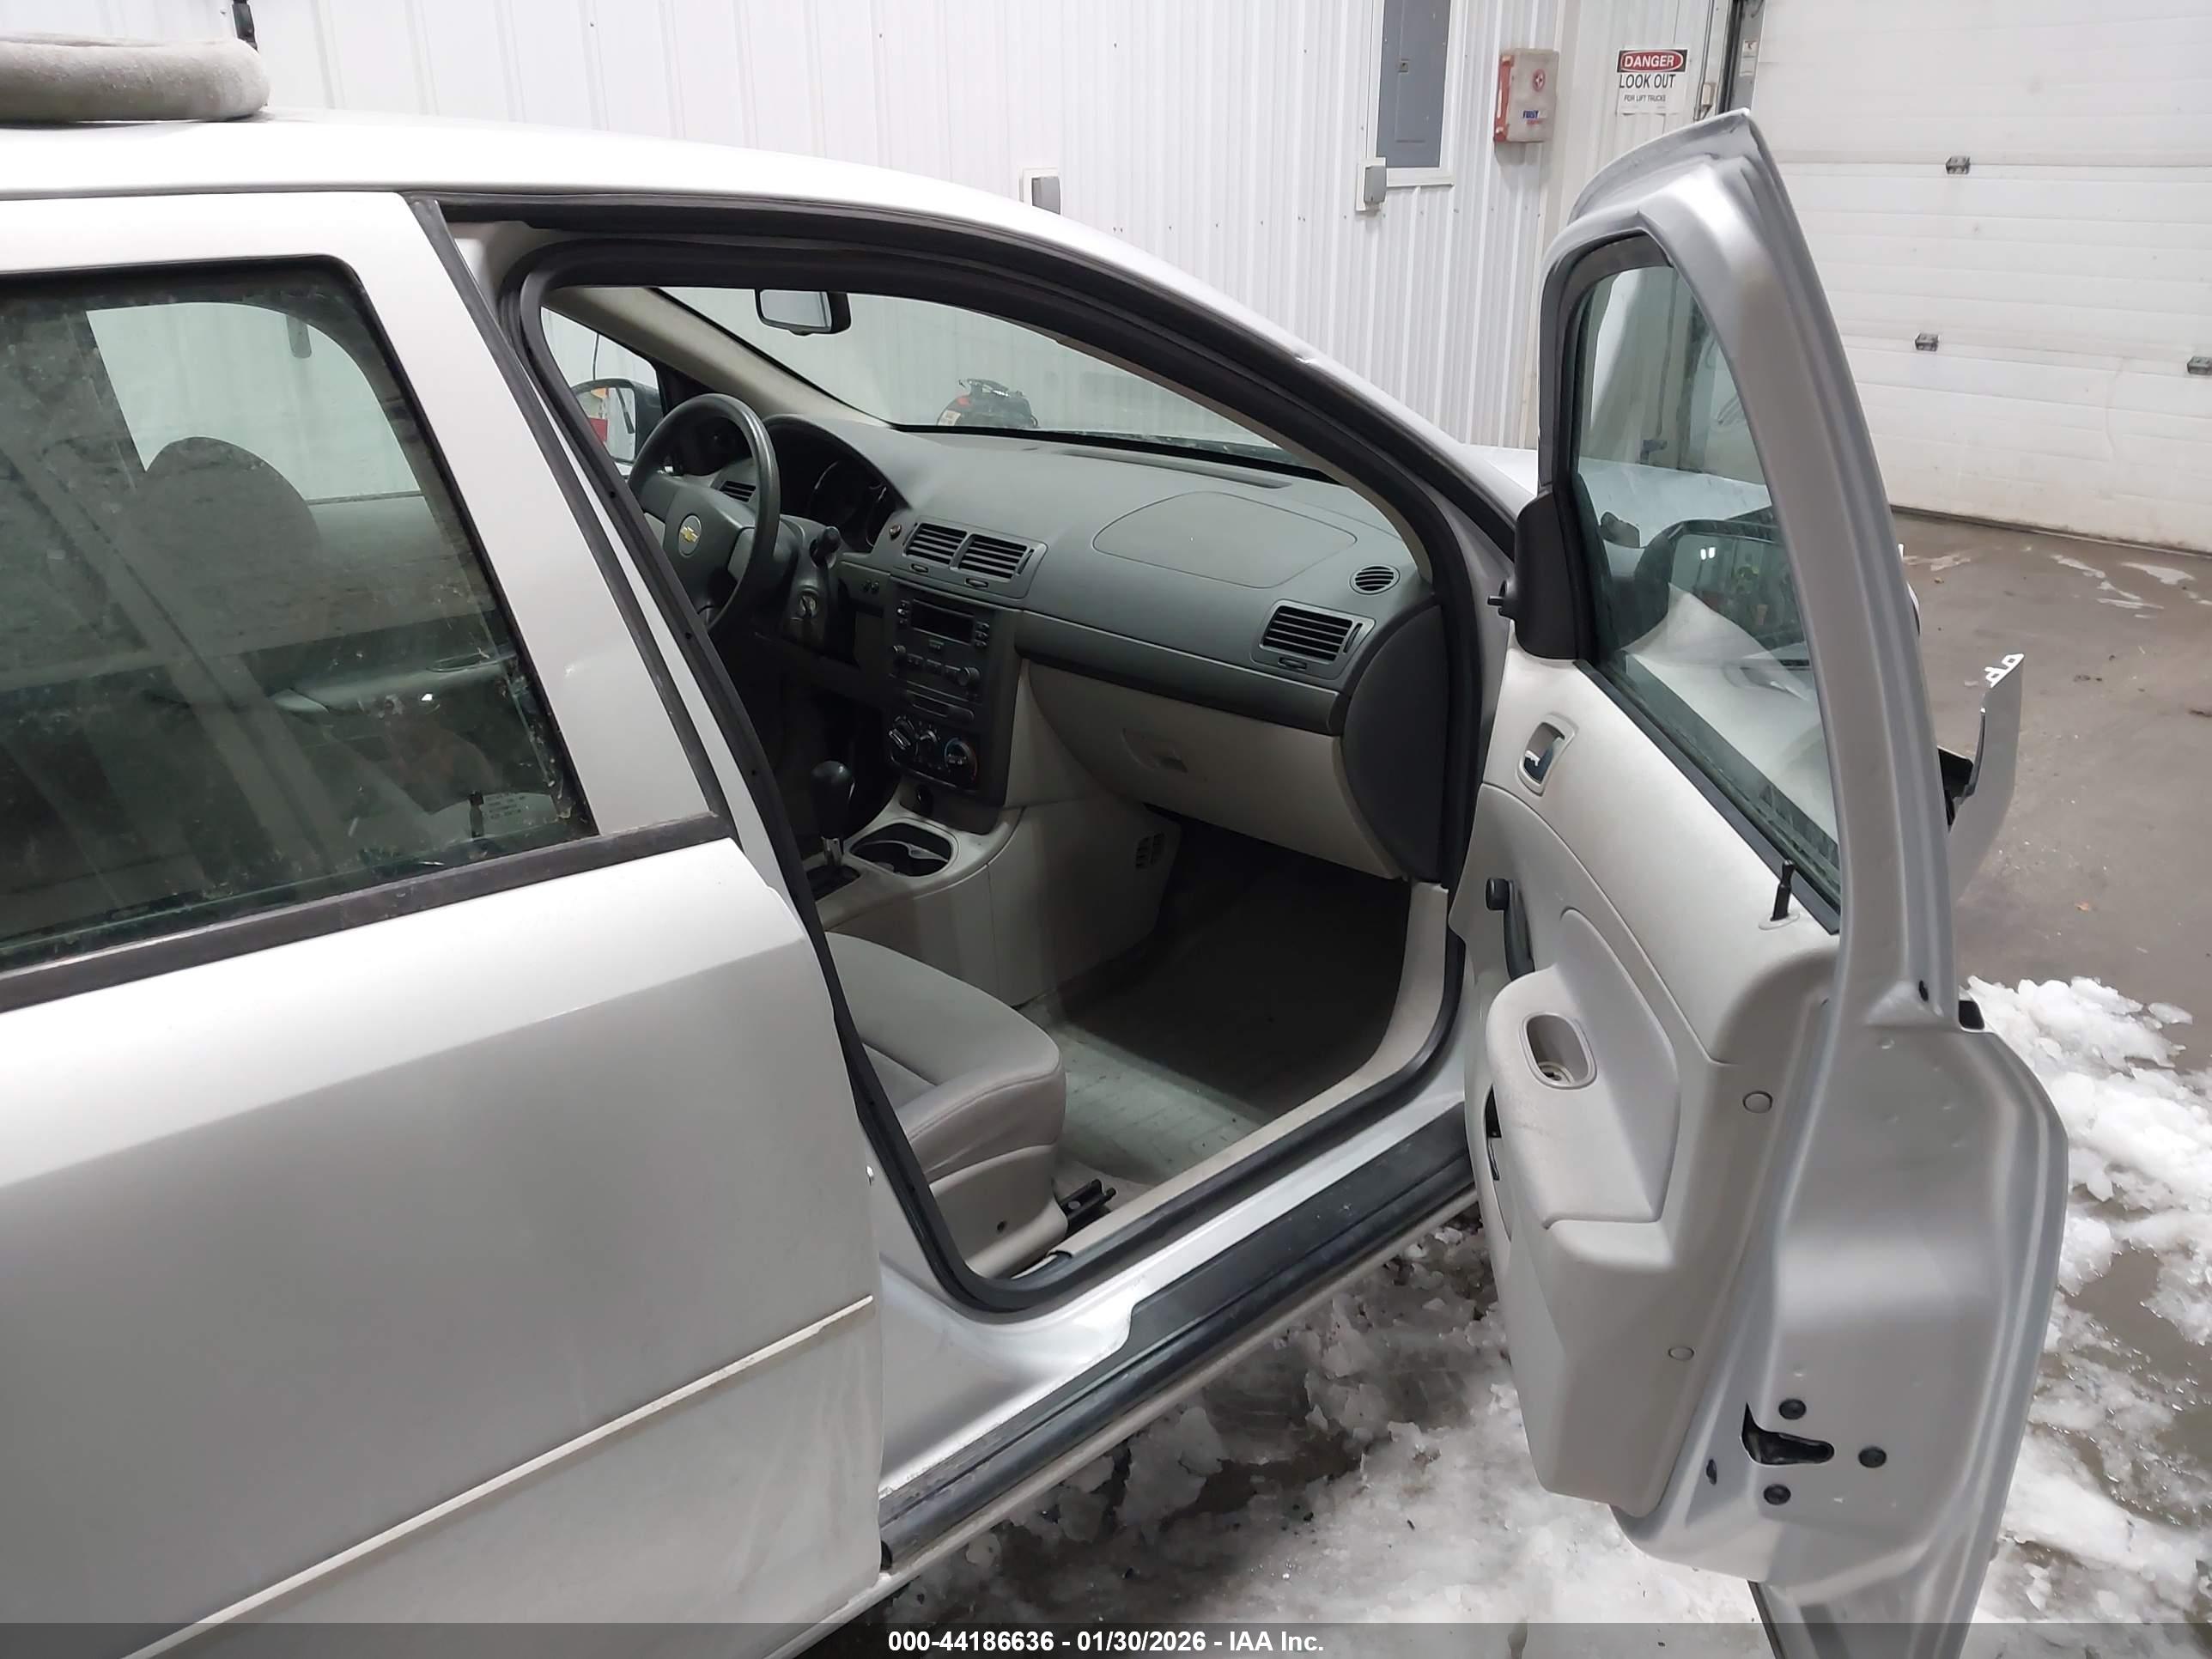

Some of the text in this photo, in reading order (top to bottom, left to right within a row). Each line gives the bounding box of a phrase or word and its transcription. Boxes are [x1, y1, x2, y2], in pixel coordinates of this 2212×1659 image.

[1624, 55, 1675, 68] DANGER
[1619, 74, 1676, 88] LOOK OUT
